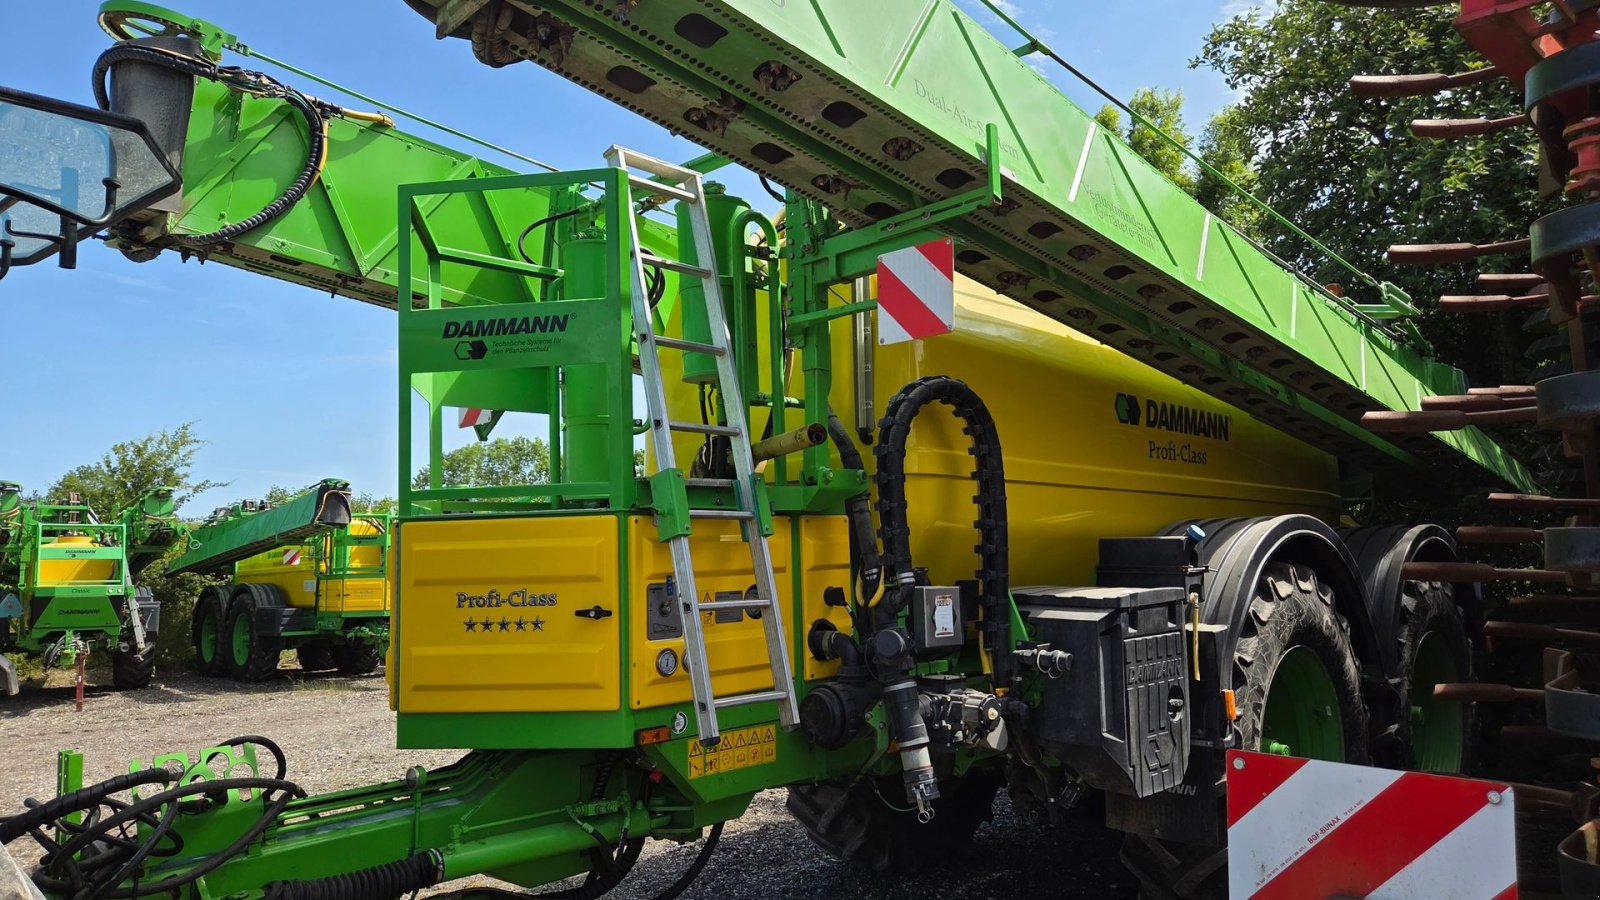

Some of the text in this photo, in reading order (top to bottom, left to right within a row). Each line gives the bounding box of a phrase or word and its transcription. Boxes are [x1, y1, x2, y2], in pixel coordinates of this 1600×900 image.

[914, 79, 1019, 160] Dual-Air-Stem
[442, 314, 569, 339] DAMMANN
[1146, 399, 1229, 441] DAMMANN
[1148, 440, 1207, 464] Profi-Class
[456, 588, 557, 608] Profi-Class
[1307, 815, 1341, 844] BGF-BUNAX
